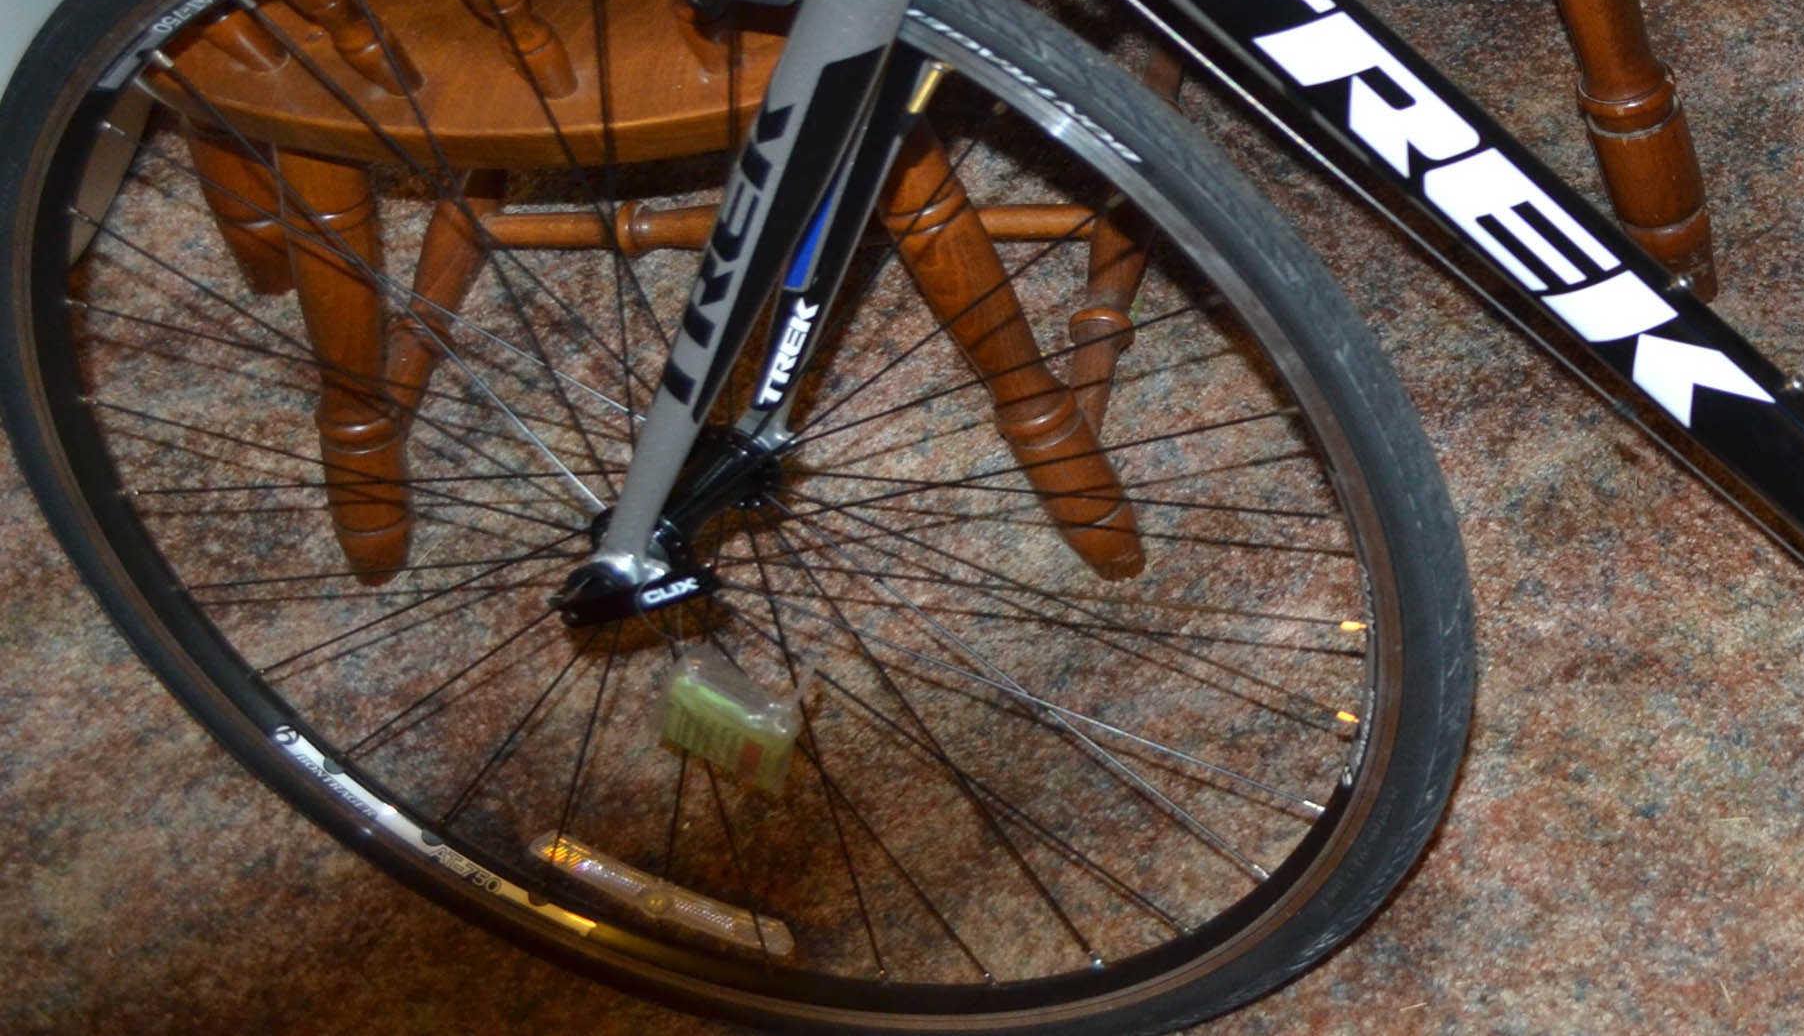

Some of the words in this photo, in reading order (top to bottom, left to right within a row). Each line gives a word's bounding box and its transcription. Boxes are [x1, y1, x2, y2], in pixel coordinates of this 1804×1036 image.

[663, 104, 796, 407] TREK
[758, 297, 820, 405] TREK
[642, 576, 700, 604] CLIX
[430, 844, 503, 894] AT-750
